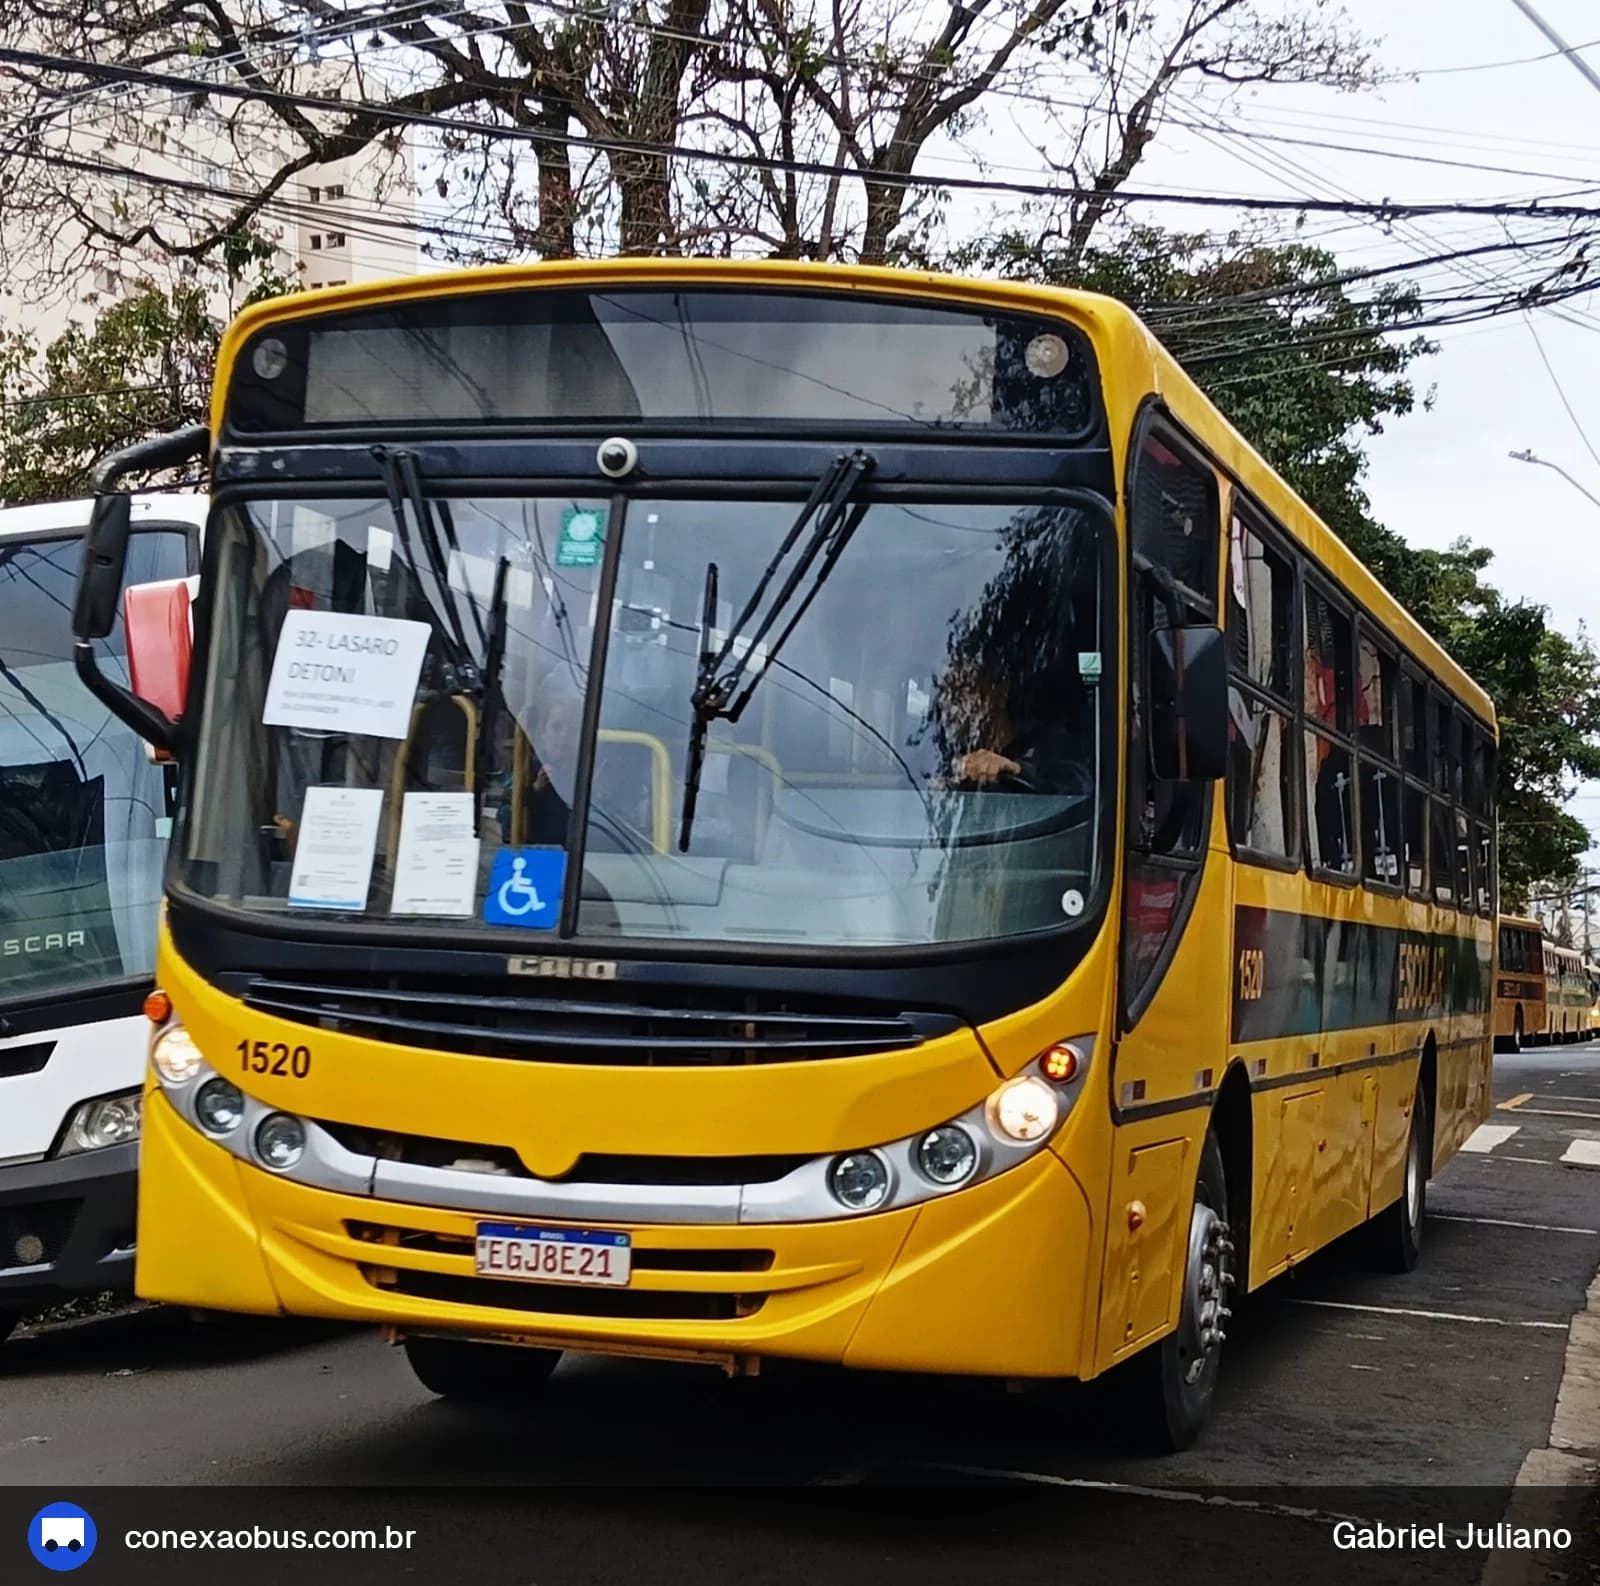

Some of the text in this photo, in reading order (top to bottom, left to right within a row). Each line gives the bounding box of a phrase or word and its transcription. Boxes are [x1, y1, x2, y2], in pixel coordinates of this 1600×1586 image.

[326, 633, 399, 656] LASARO
[287, 661, 357, 684] DETONI
[236, 1039, 312, 1079] 1520
[488, 1240, 612, 1278] EGJ8E21
